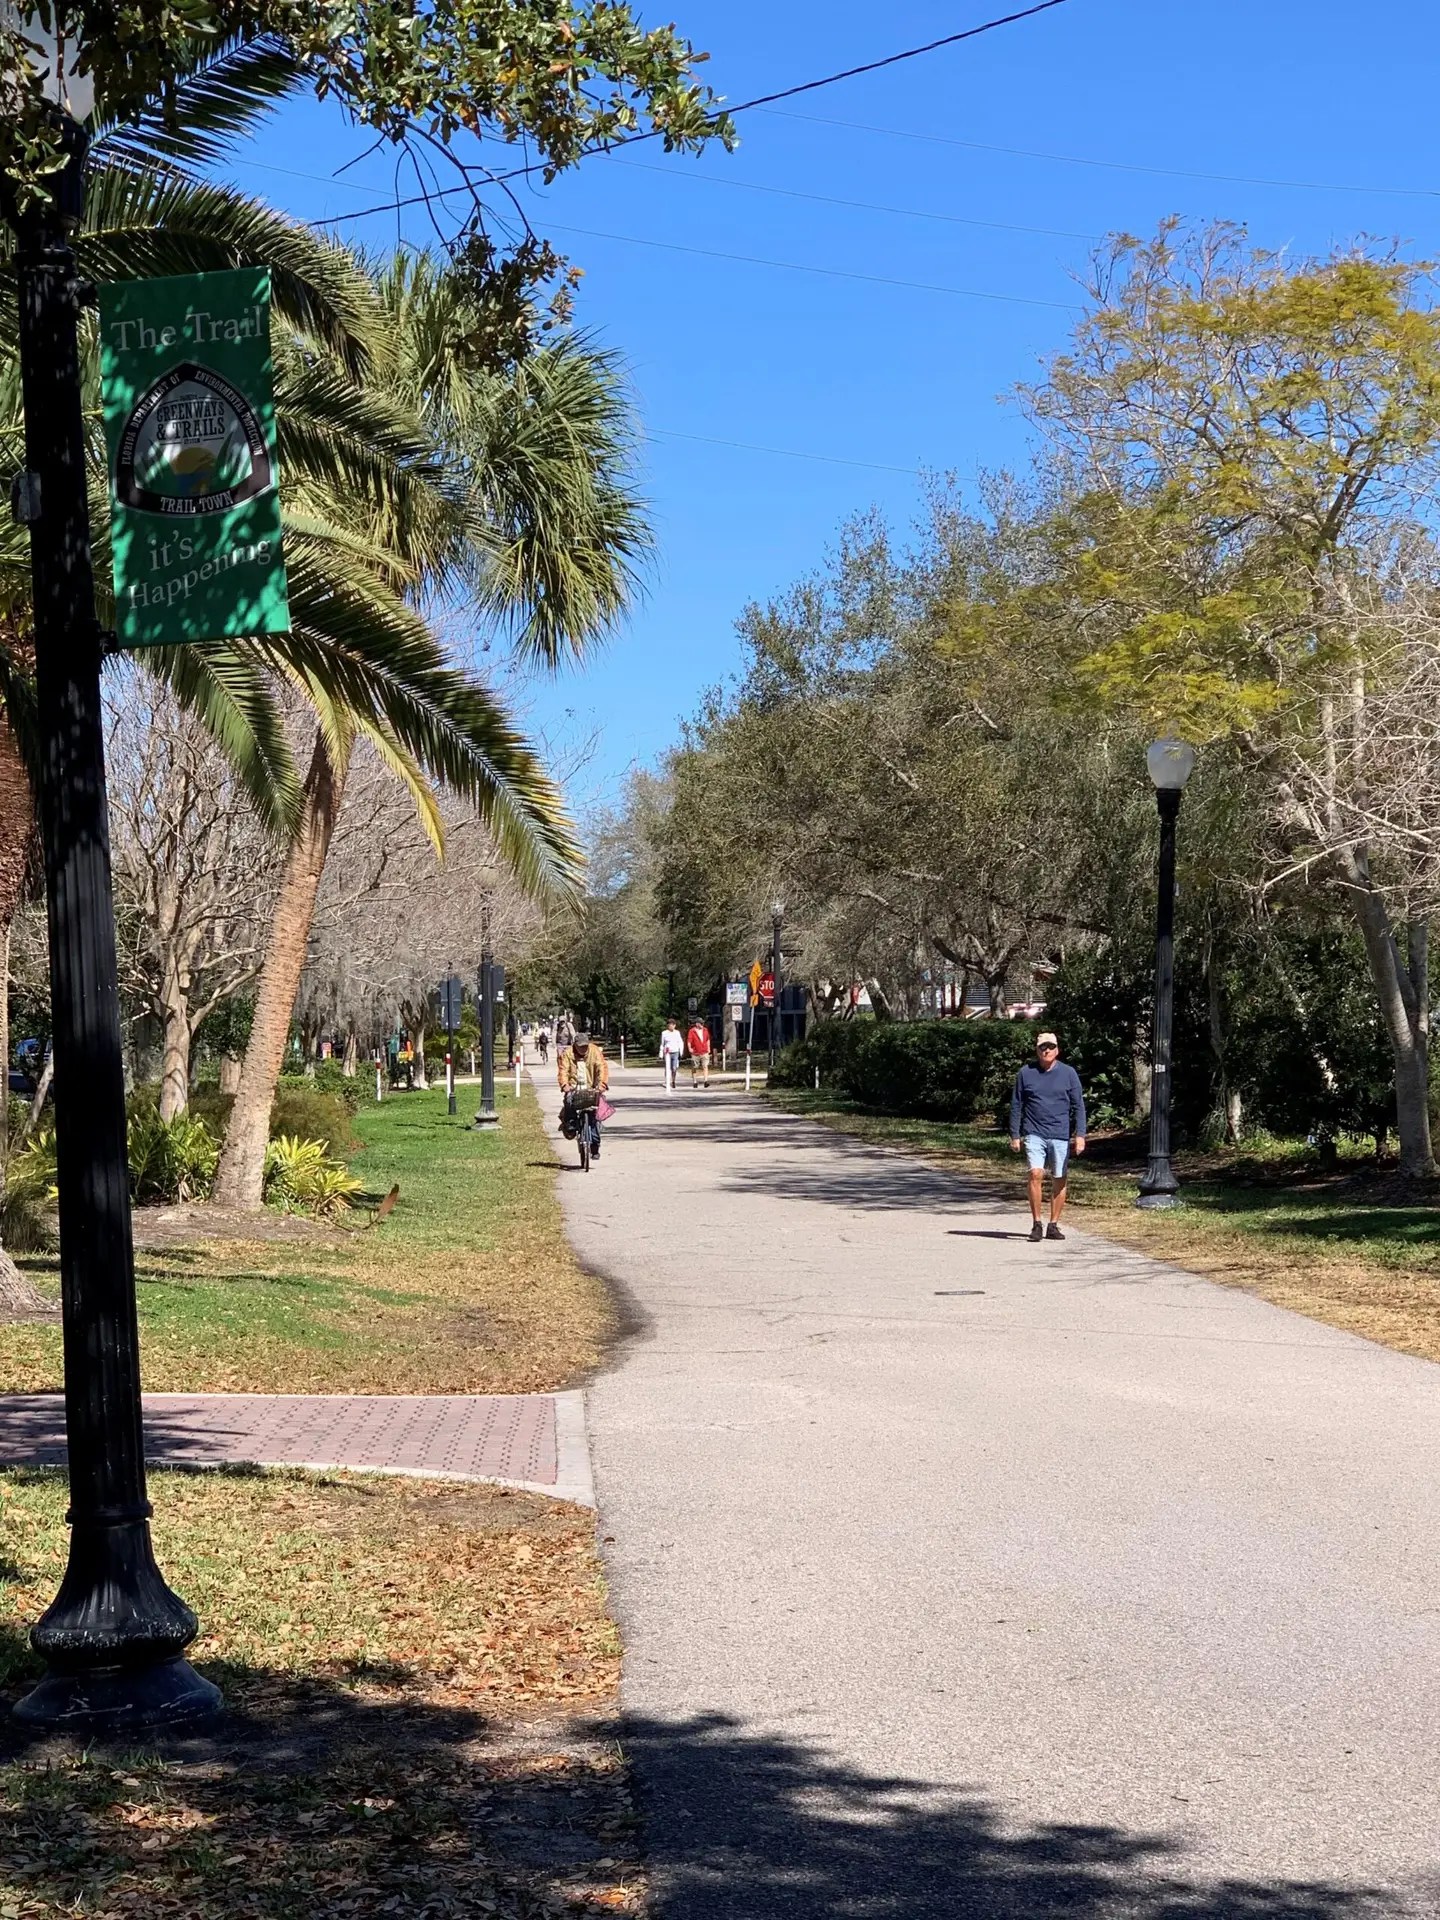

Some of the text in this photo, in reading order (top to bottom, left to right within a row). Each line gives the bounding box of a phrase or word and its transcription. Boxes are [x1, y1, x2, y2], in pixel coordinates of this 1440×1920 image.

[110, 304, 263, 351] The Trail
[121, 373, 180, 465] FLORIDA DEPARTMENT OF
[156, 401, 225, 422] GREENWAYS
[156, 417, 226, 440] & TRAILS
[194, 370, 264, 456] ENVIRONMENTAL PROTECTION
[160, 490, 233, 513] TRAIL TOWN
[128, 540, 272, 610] Happening
[759, 980, 775, 990] STO
